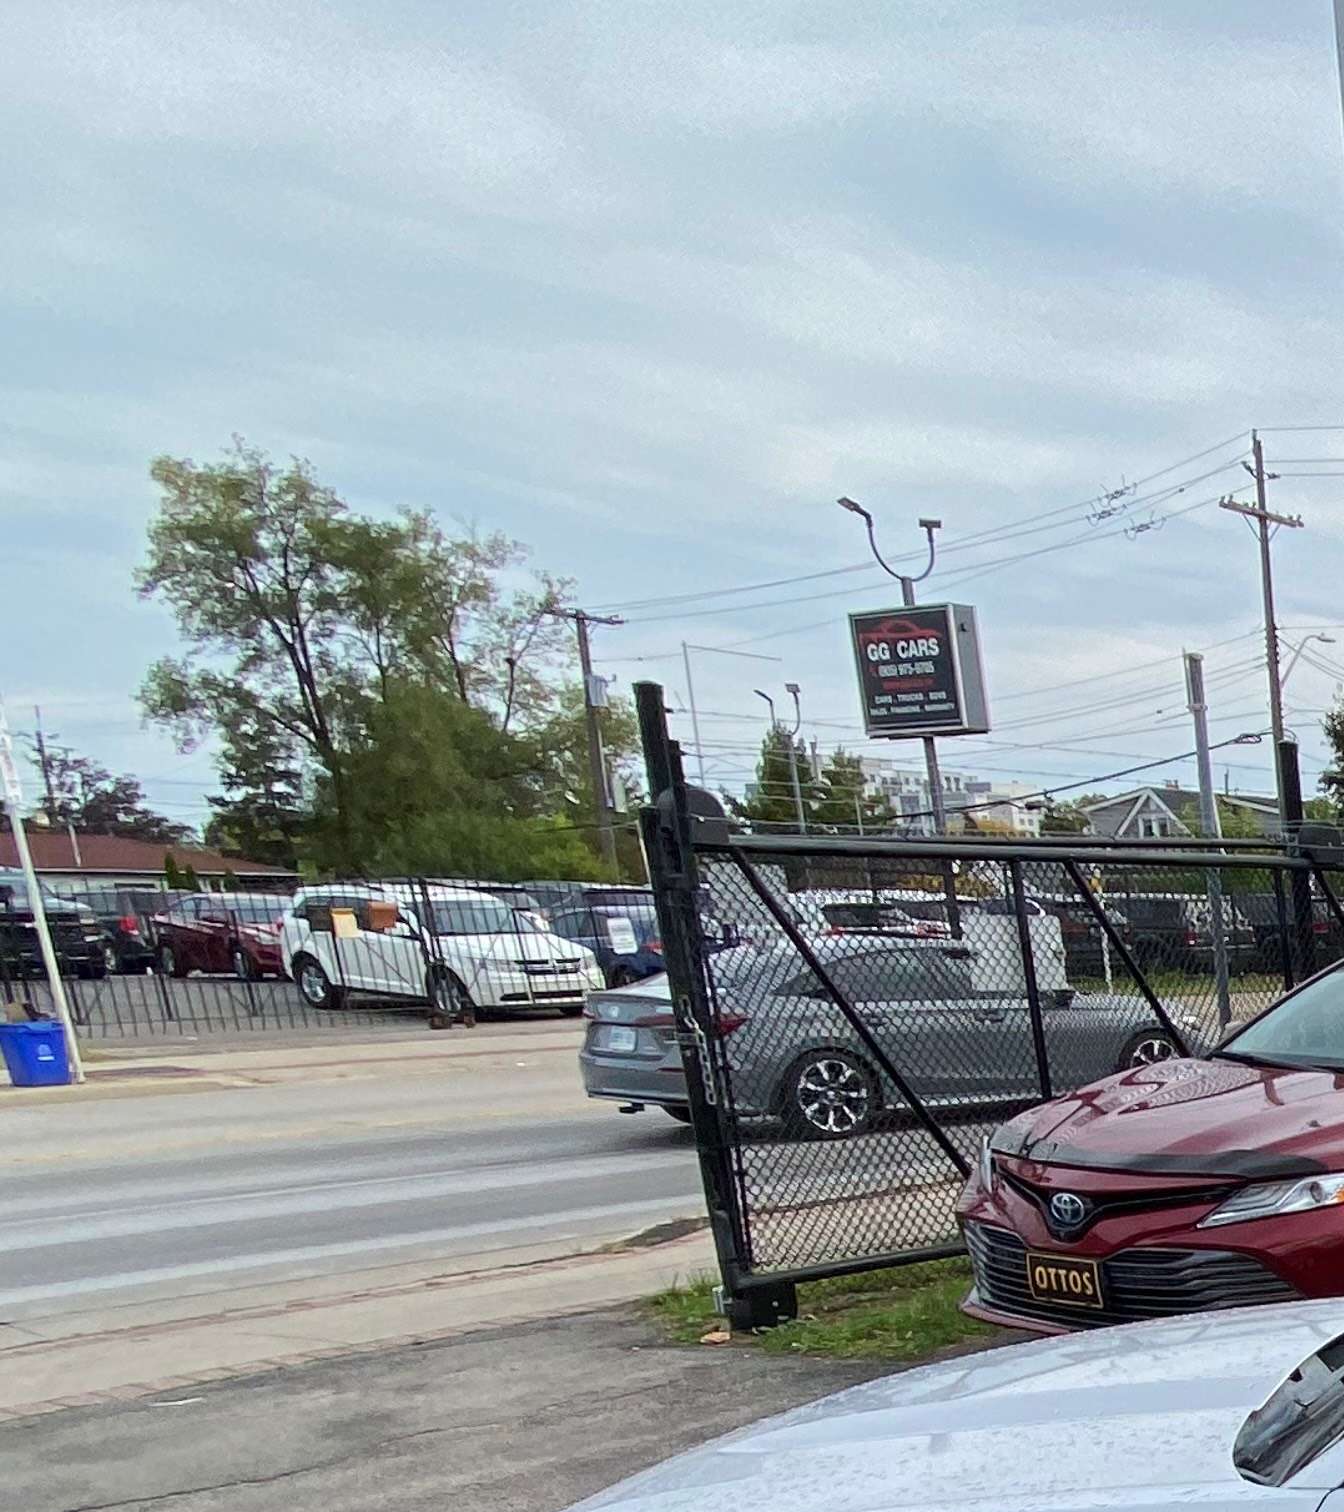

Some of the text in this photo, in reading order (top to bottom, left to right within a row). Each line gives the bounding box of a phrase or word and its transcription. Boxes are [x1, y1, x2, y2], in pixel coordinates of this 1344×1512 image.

[866, 637, 940, 662] GG CARS
[1034, 1266, 1093, 1296] OTTOS
